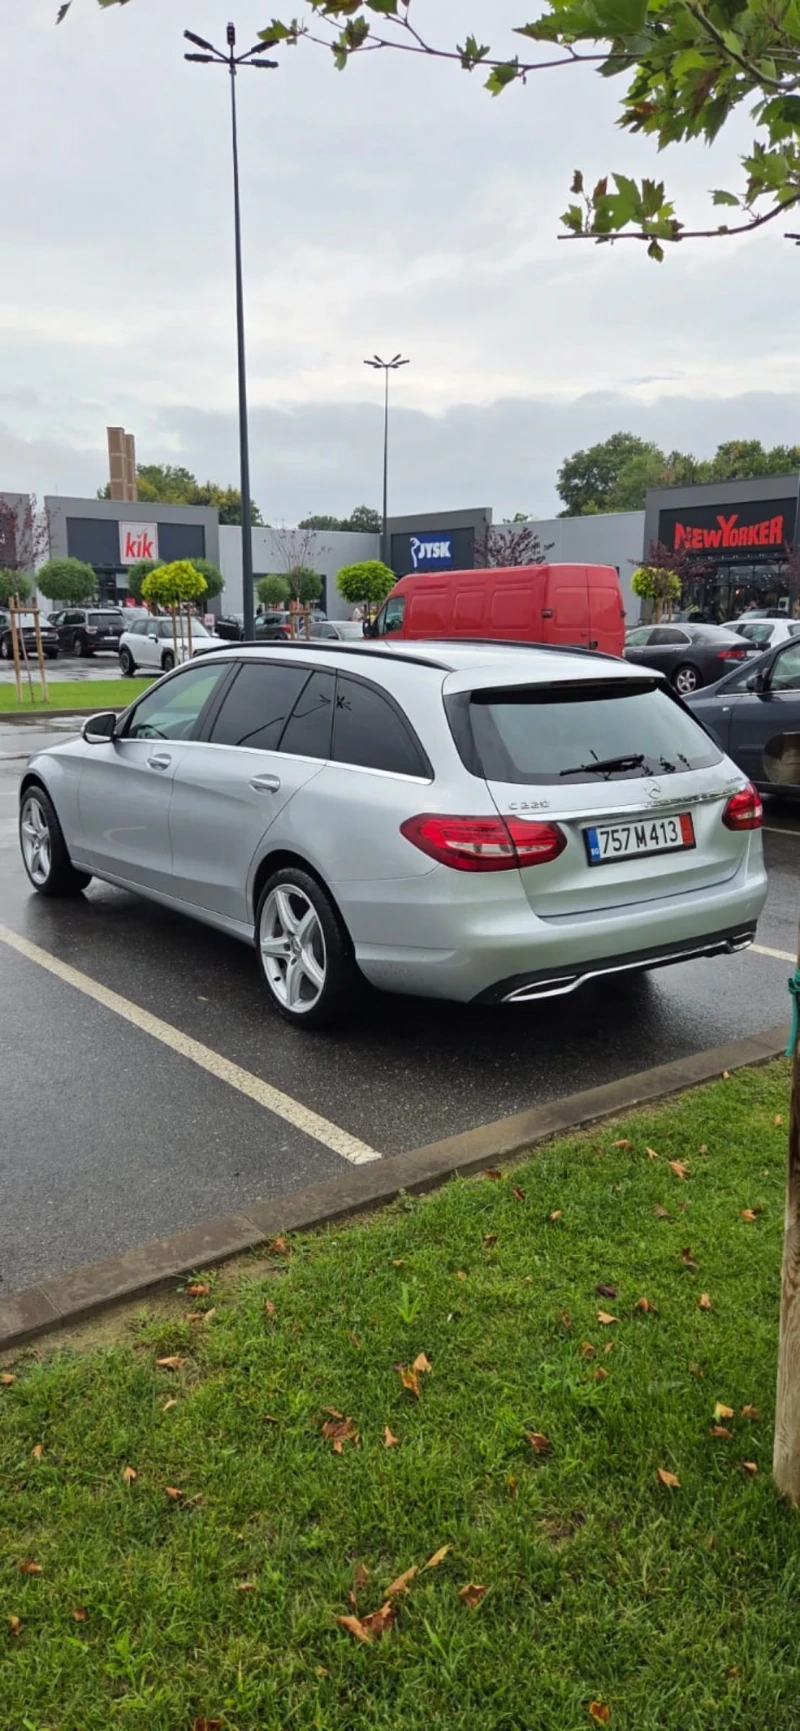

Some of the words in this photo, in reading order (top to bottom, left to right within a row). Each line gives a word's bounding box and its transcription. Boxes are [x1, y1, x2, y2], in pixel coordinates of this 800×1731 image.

[125, 530, 154, 558] kik
[418, 541, 451, 559] JYSK
[600, 827, 631, 854] 757
[634, 825, 648, 848] M
[649, 820, 679, 845] 413
